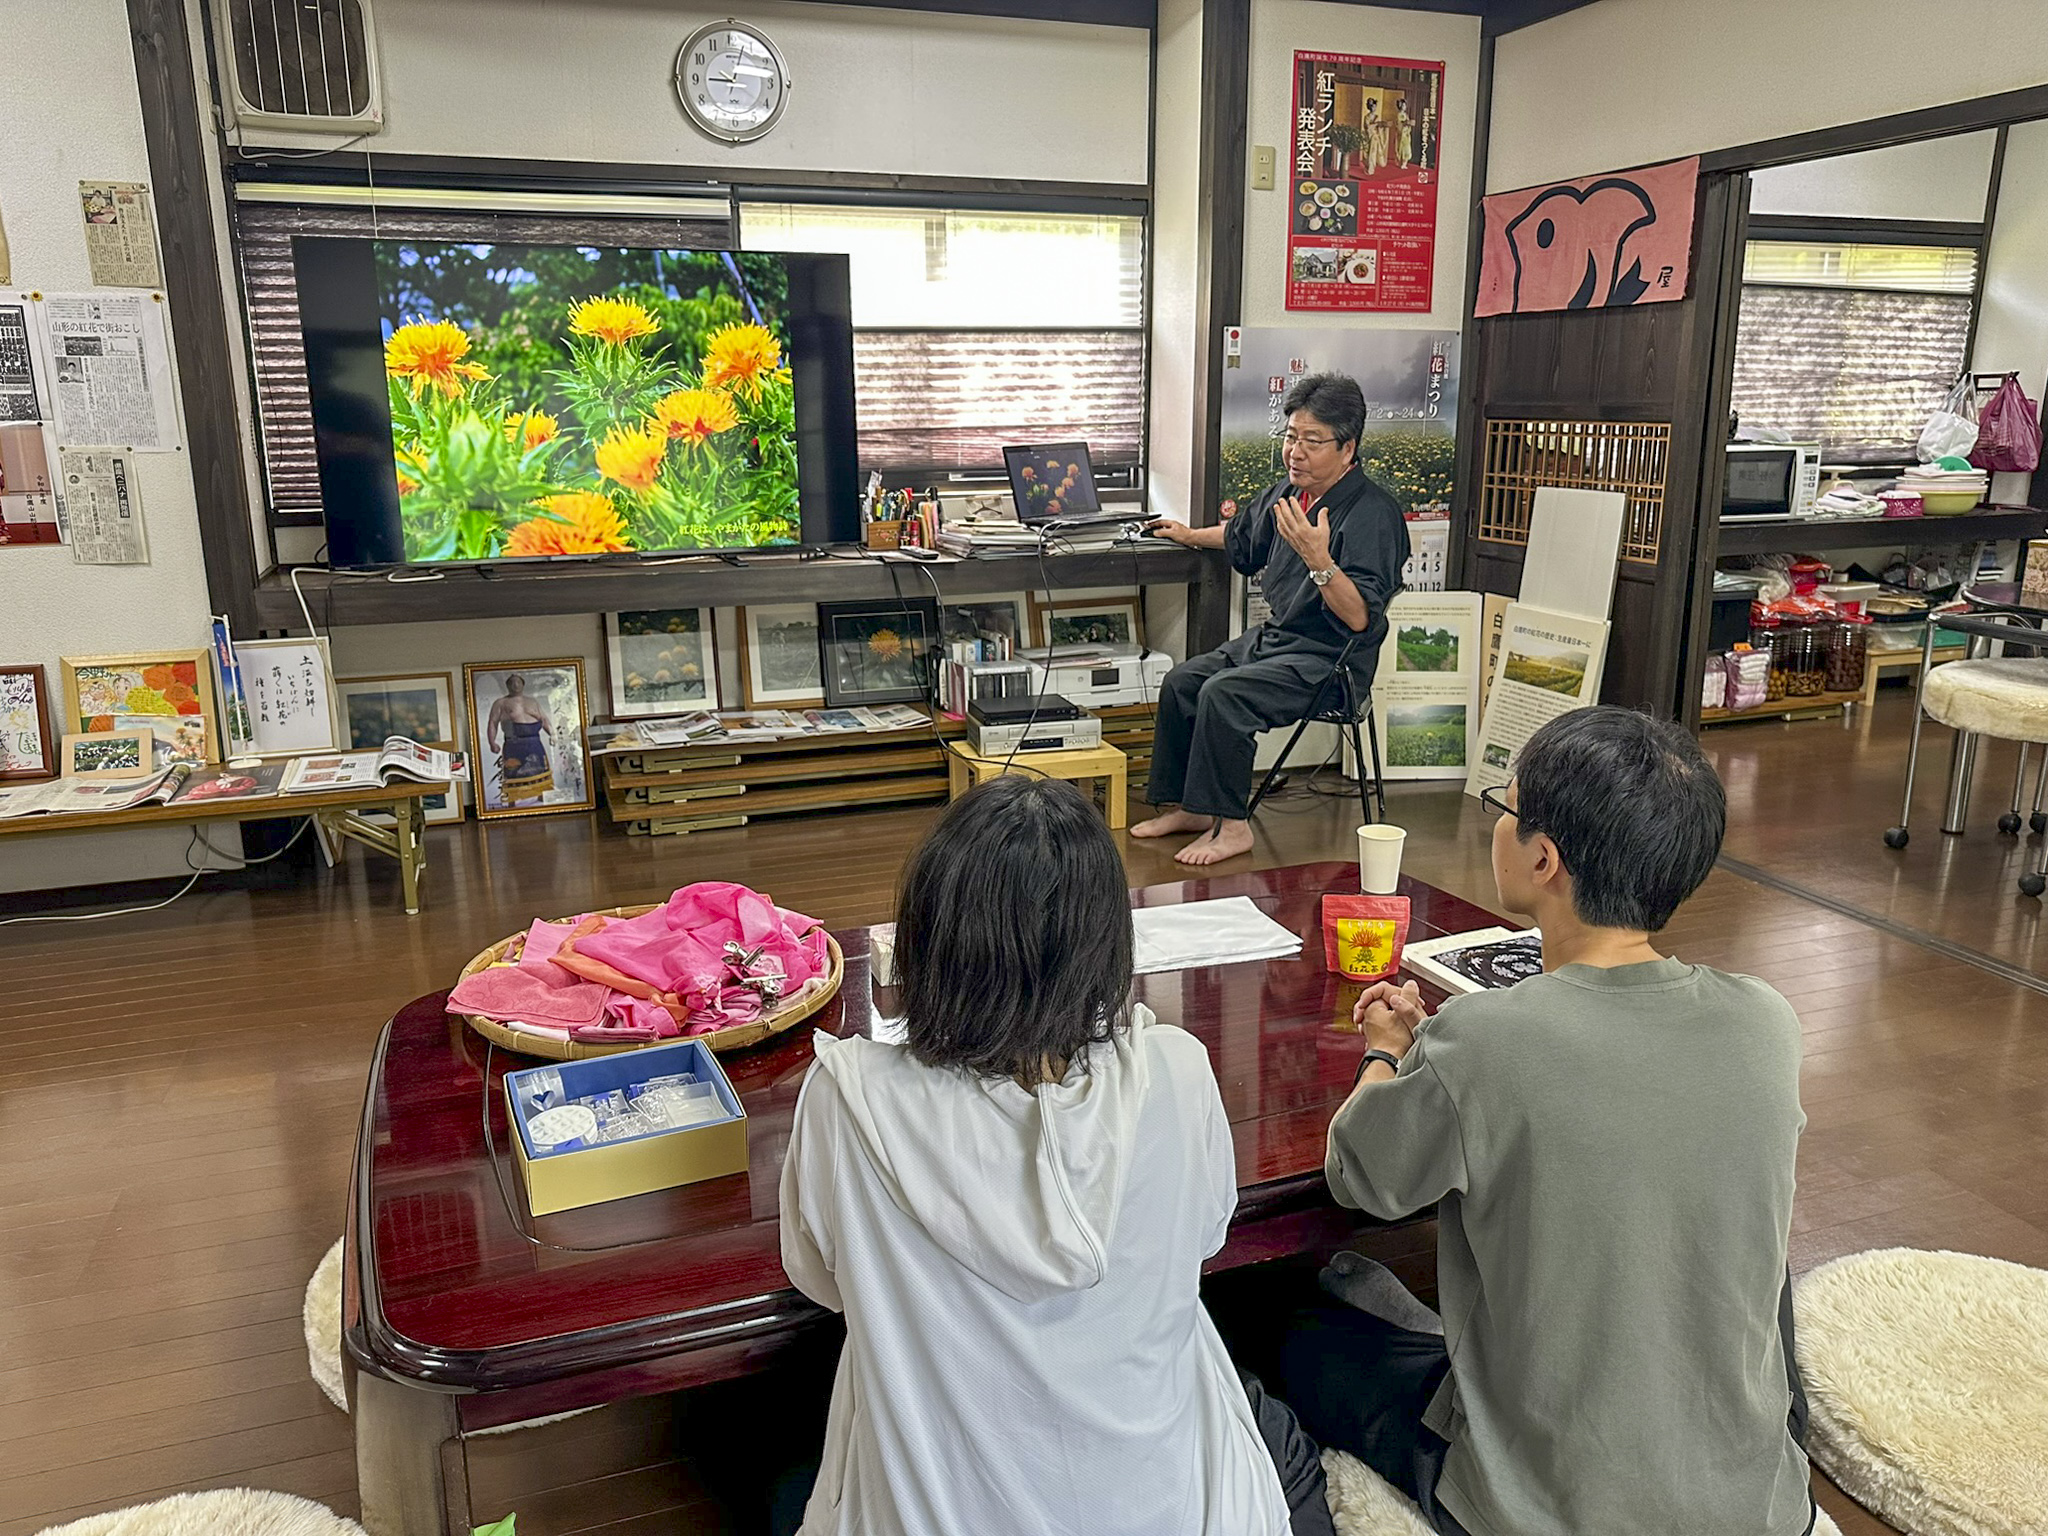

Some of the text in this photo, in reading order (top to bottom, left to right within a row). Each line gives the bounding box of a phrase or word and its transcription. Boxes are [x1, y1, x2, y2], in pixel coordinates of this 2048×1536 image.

[709, 39, 717, 51] 11
[695, 53, 705, 65] 10
[692, 73, 699, 85] 9
[767, 78, 774, 90] 3
[698, 93, 705, 105] 8
[763, 98, 769, 109] 4
[1315, 70, 1336, 157] 紅ランチ
[732, 116, 739, 127] 6
[1297, 107, 1316, 173] 発表会
[1428, 340, 1445, 418] 紅花まつり
[1407, 563, 1413, 573] 3
[1421, 562, 1427, 573] 4
[1434, 561, 1440, 572] 5
